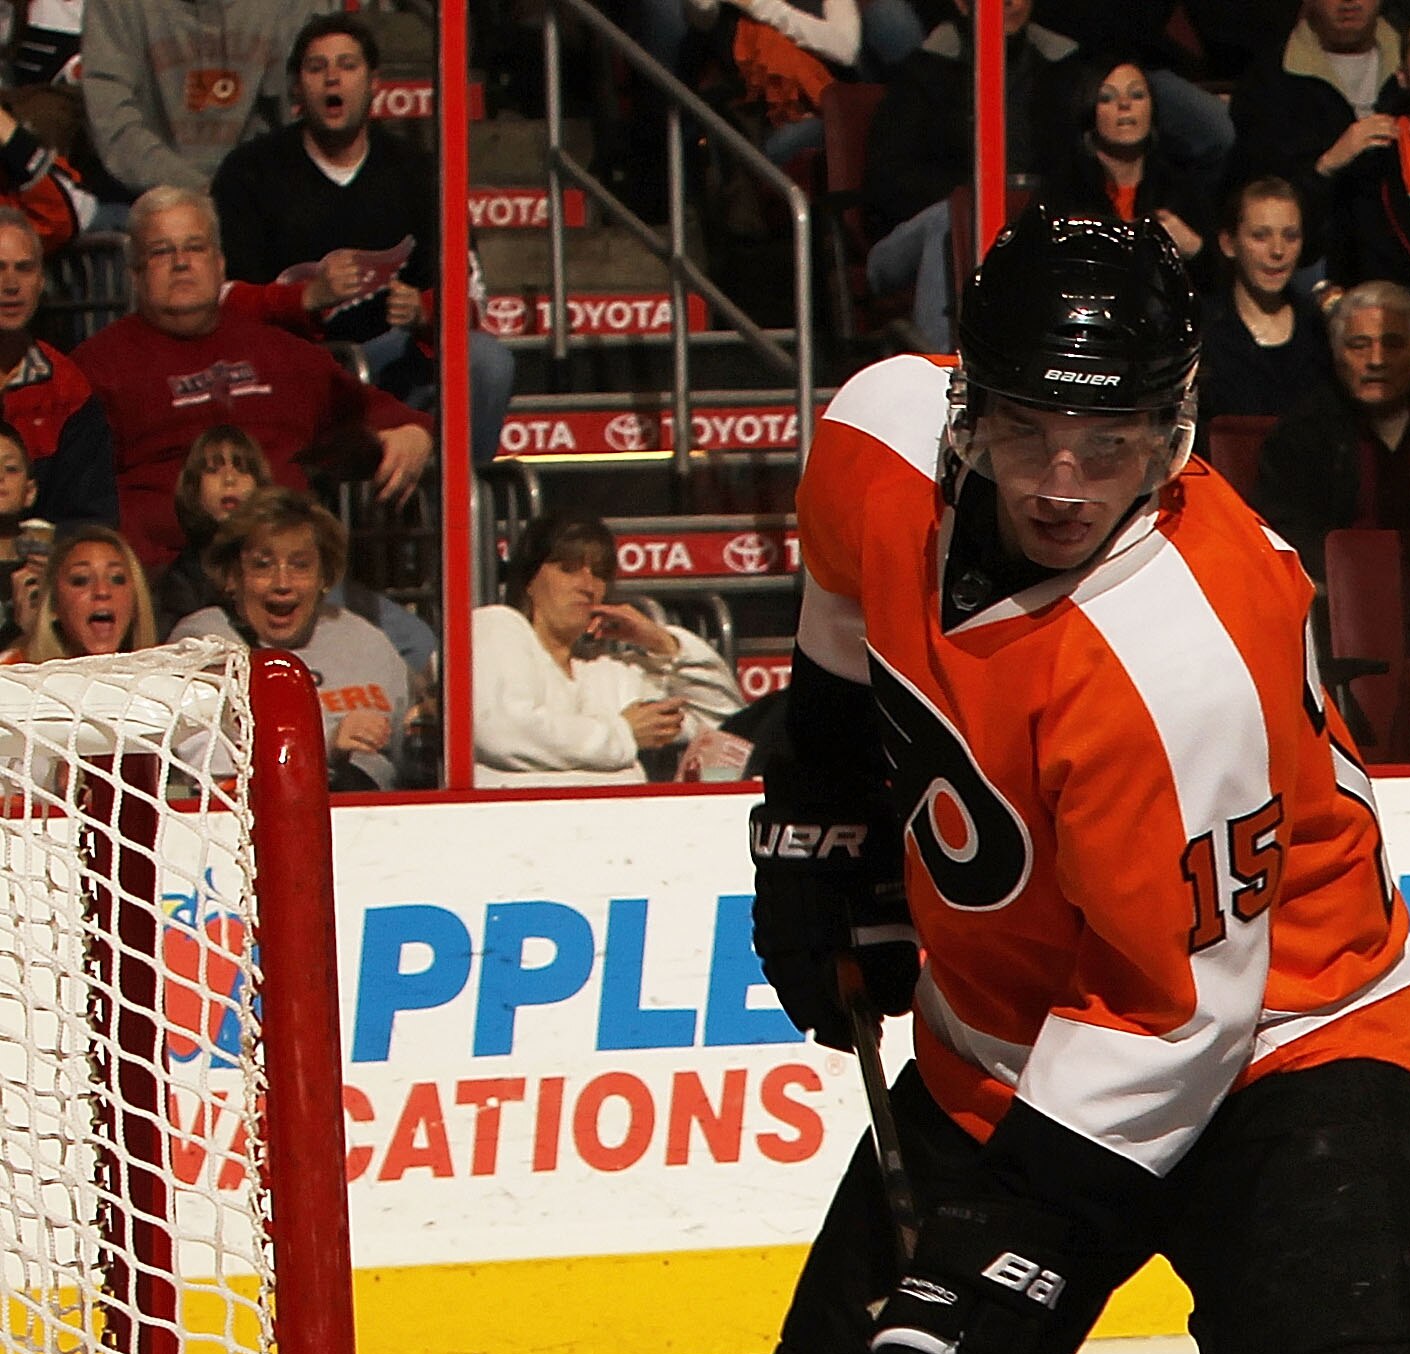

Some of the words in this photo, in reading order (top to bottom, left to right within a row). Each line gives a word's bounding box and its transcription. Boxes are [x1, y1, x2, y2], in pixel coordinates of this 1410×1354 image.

[1044, 369, 1121, 386] BAUER
[500, 421, 577, 451] OTA
[618, 541, 693, 572] OTA
[320, 684, 392, 713] ERS
[749, 820, 868, 859] UER
[1179, 792, 1286, 956] 15
